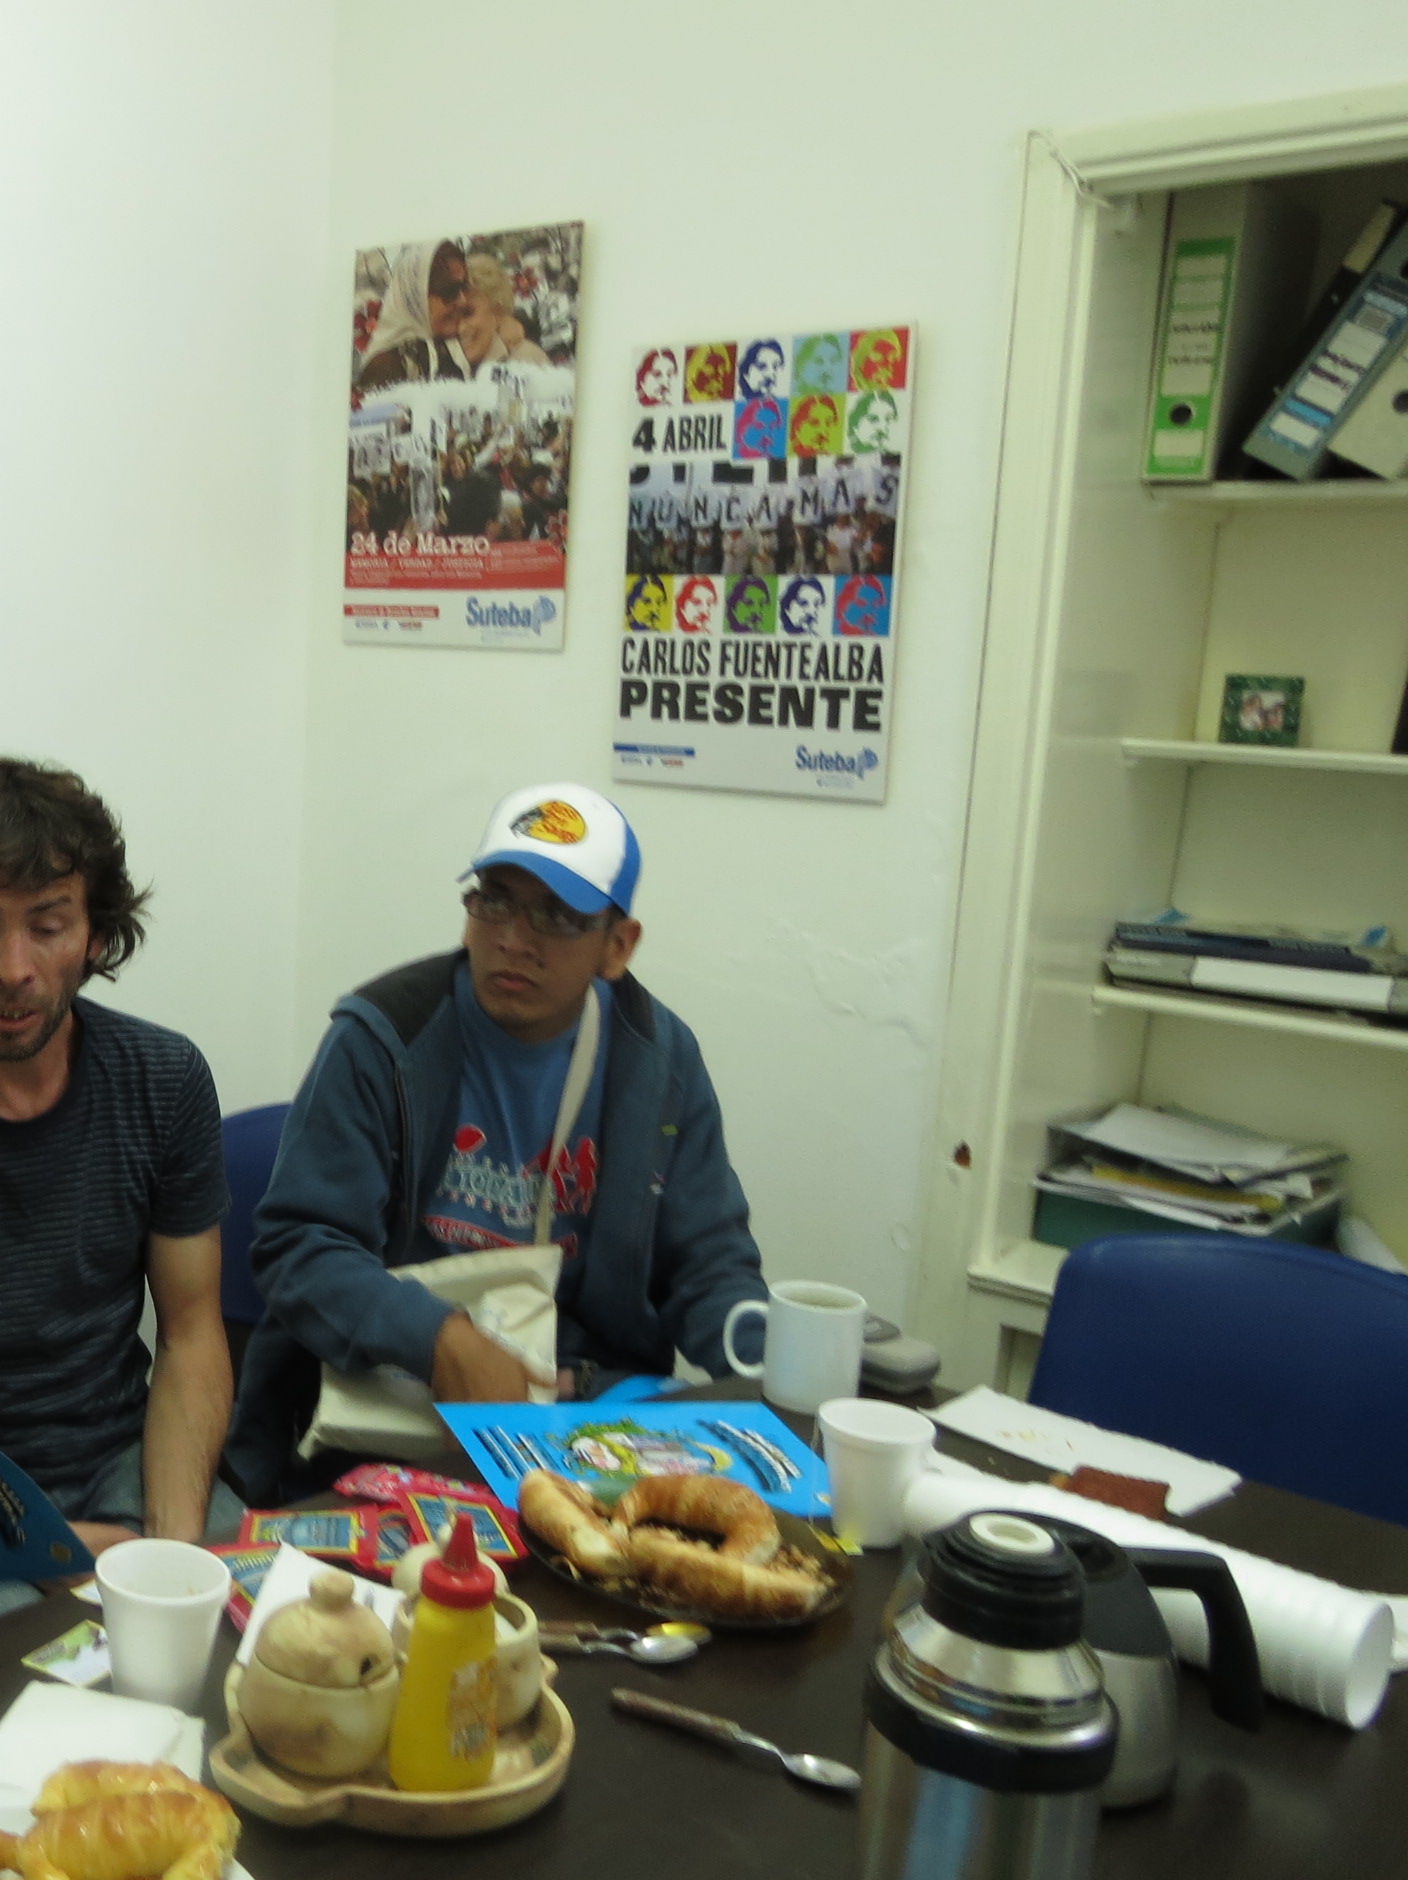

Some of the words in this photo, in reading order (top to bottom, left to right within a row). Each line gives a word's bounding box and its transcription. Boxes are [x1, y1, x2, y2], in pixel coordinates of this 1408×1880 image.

[632, 416, 656, 453] 4
[662, 413, 727, 454] ABRIL
[629, 494, 771, 524] NUNCA
[351, 532, 378, 555] 24
[383, 530, 412, 556] de
[416, 531, 491, 556] Marzo
[465, 596, 532, 629] Suteba
[620, 636, 712, 677] CARLOS
[718, 639, 884, 684] FUENTEALBA
[619, 678, 883, 732] PRESENTE
[795, 743, 857, 772] Suteba
